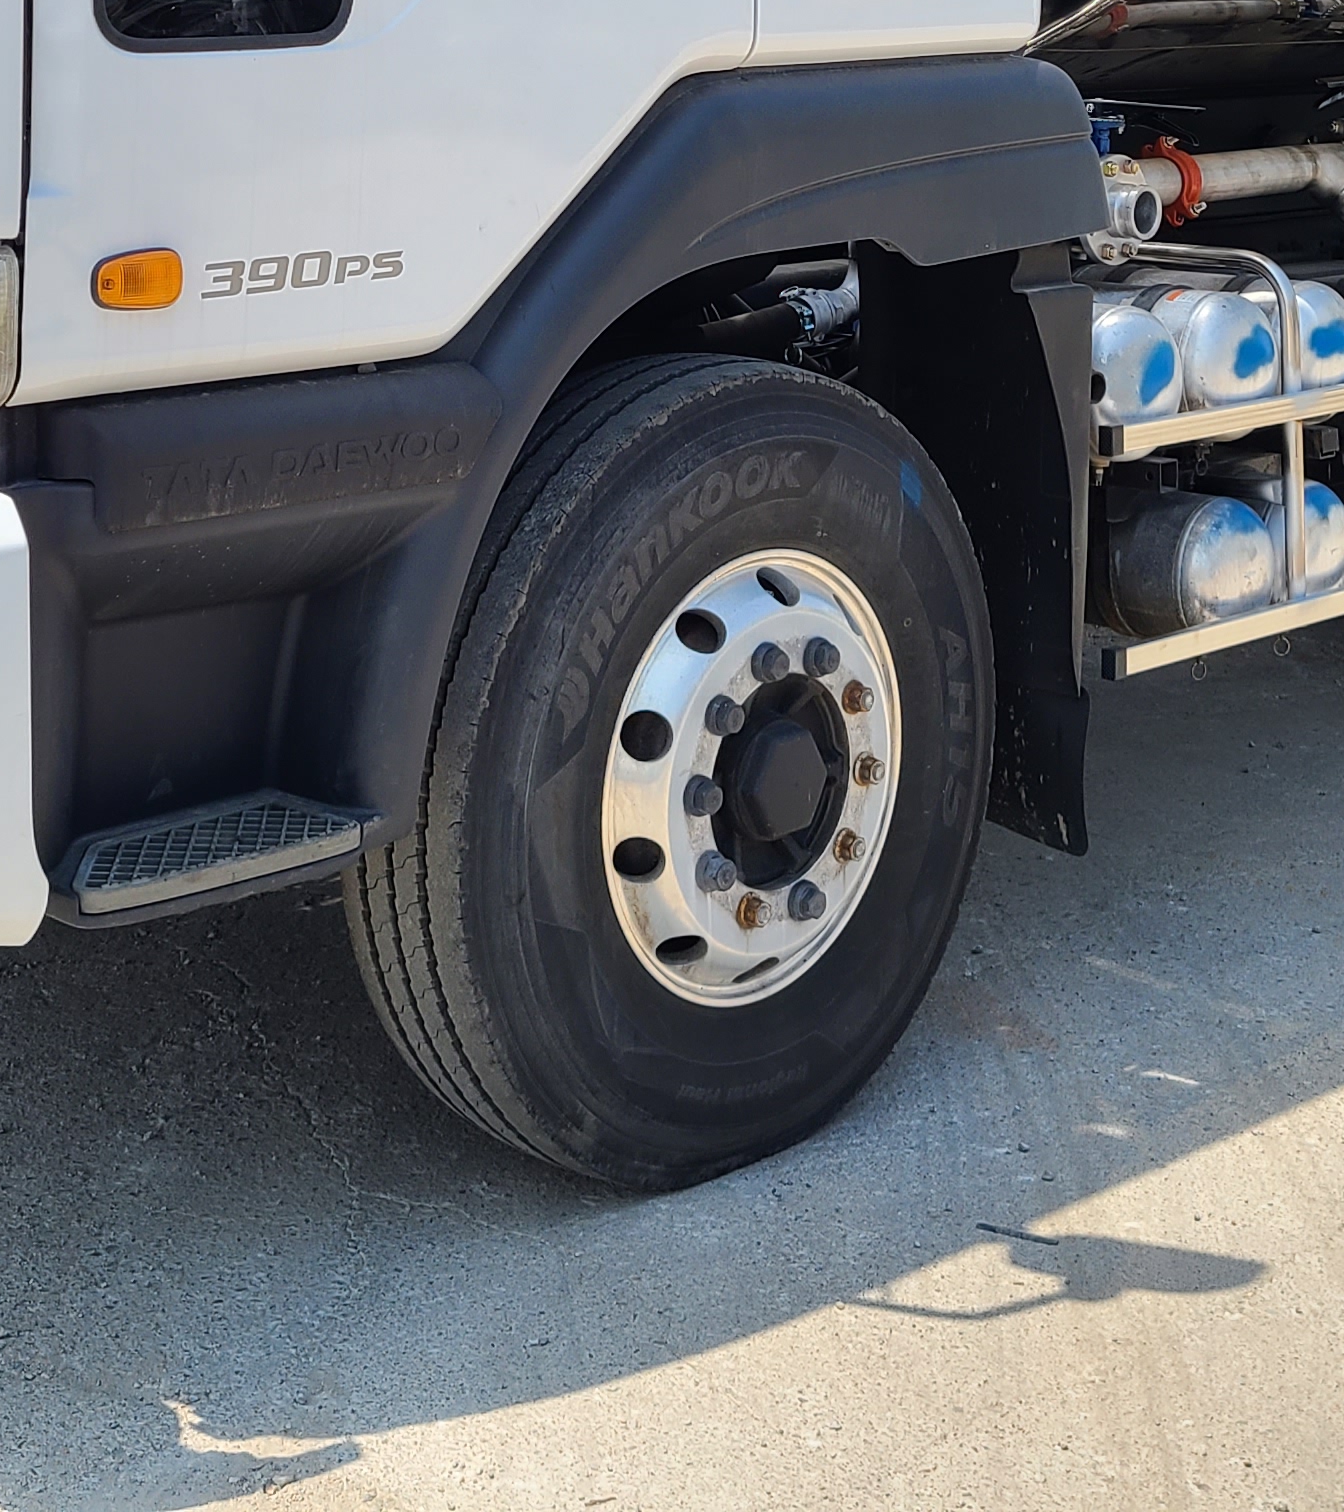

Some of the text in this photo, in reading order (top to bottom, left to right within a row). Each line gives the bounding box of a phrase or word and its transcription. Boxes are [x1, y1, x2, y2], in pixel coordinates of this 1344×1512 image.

[200, 250, 404, 300] 390PS
[140, 426, 461, 501] TATA DAEWOO
